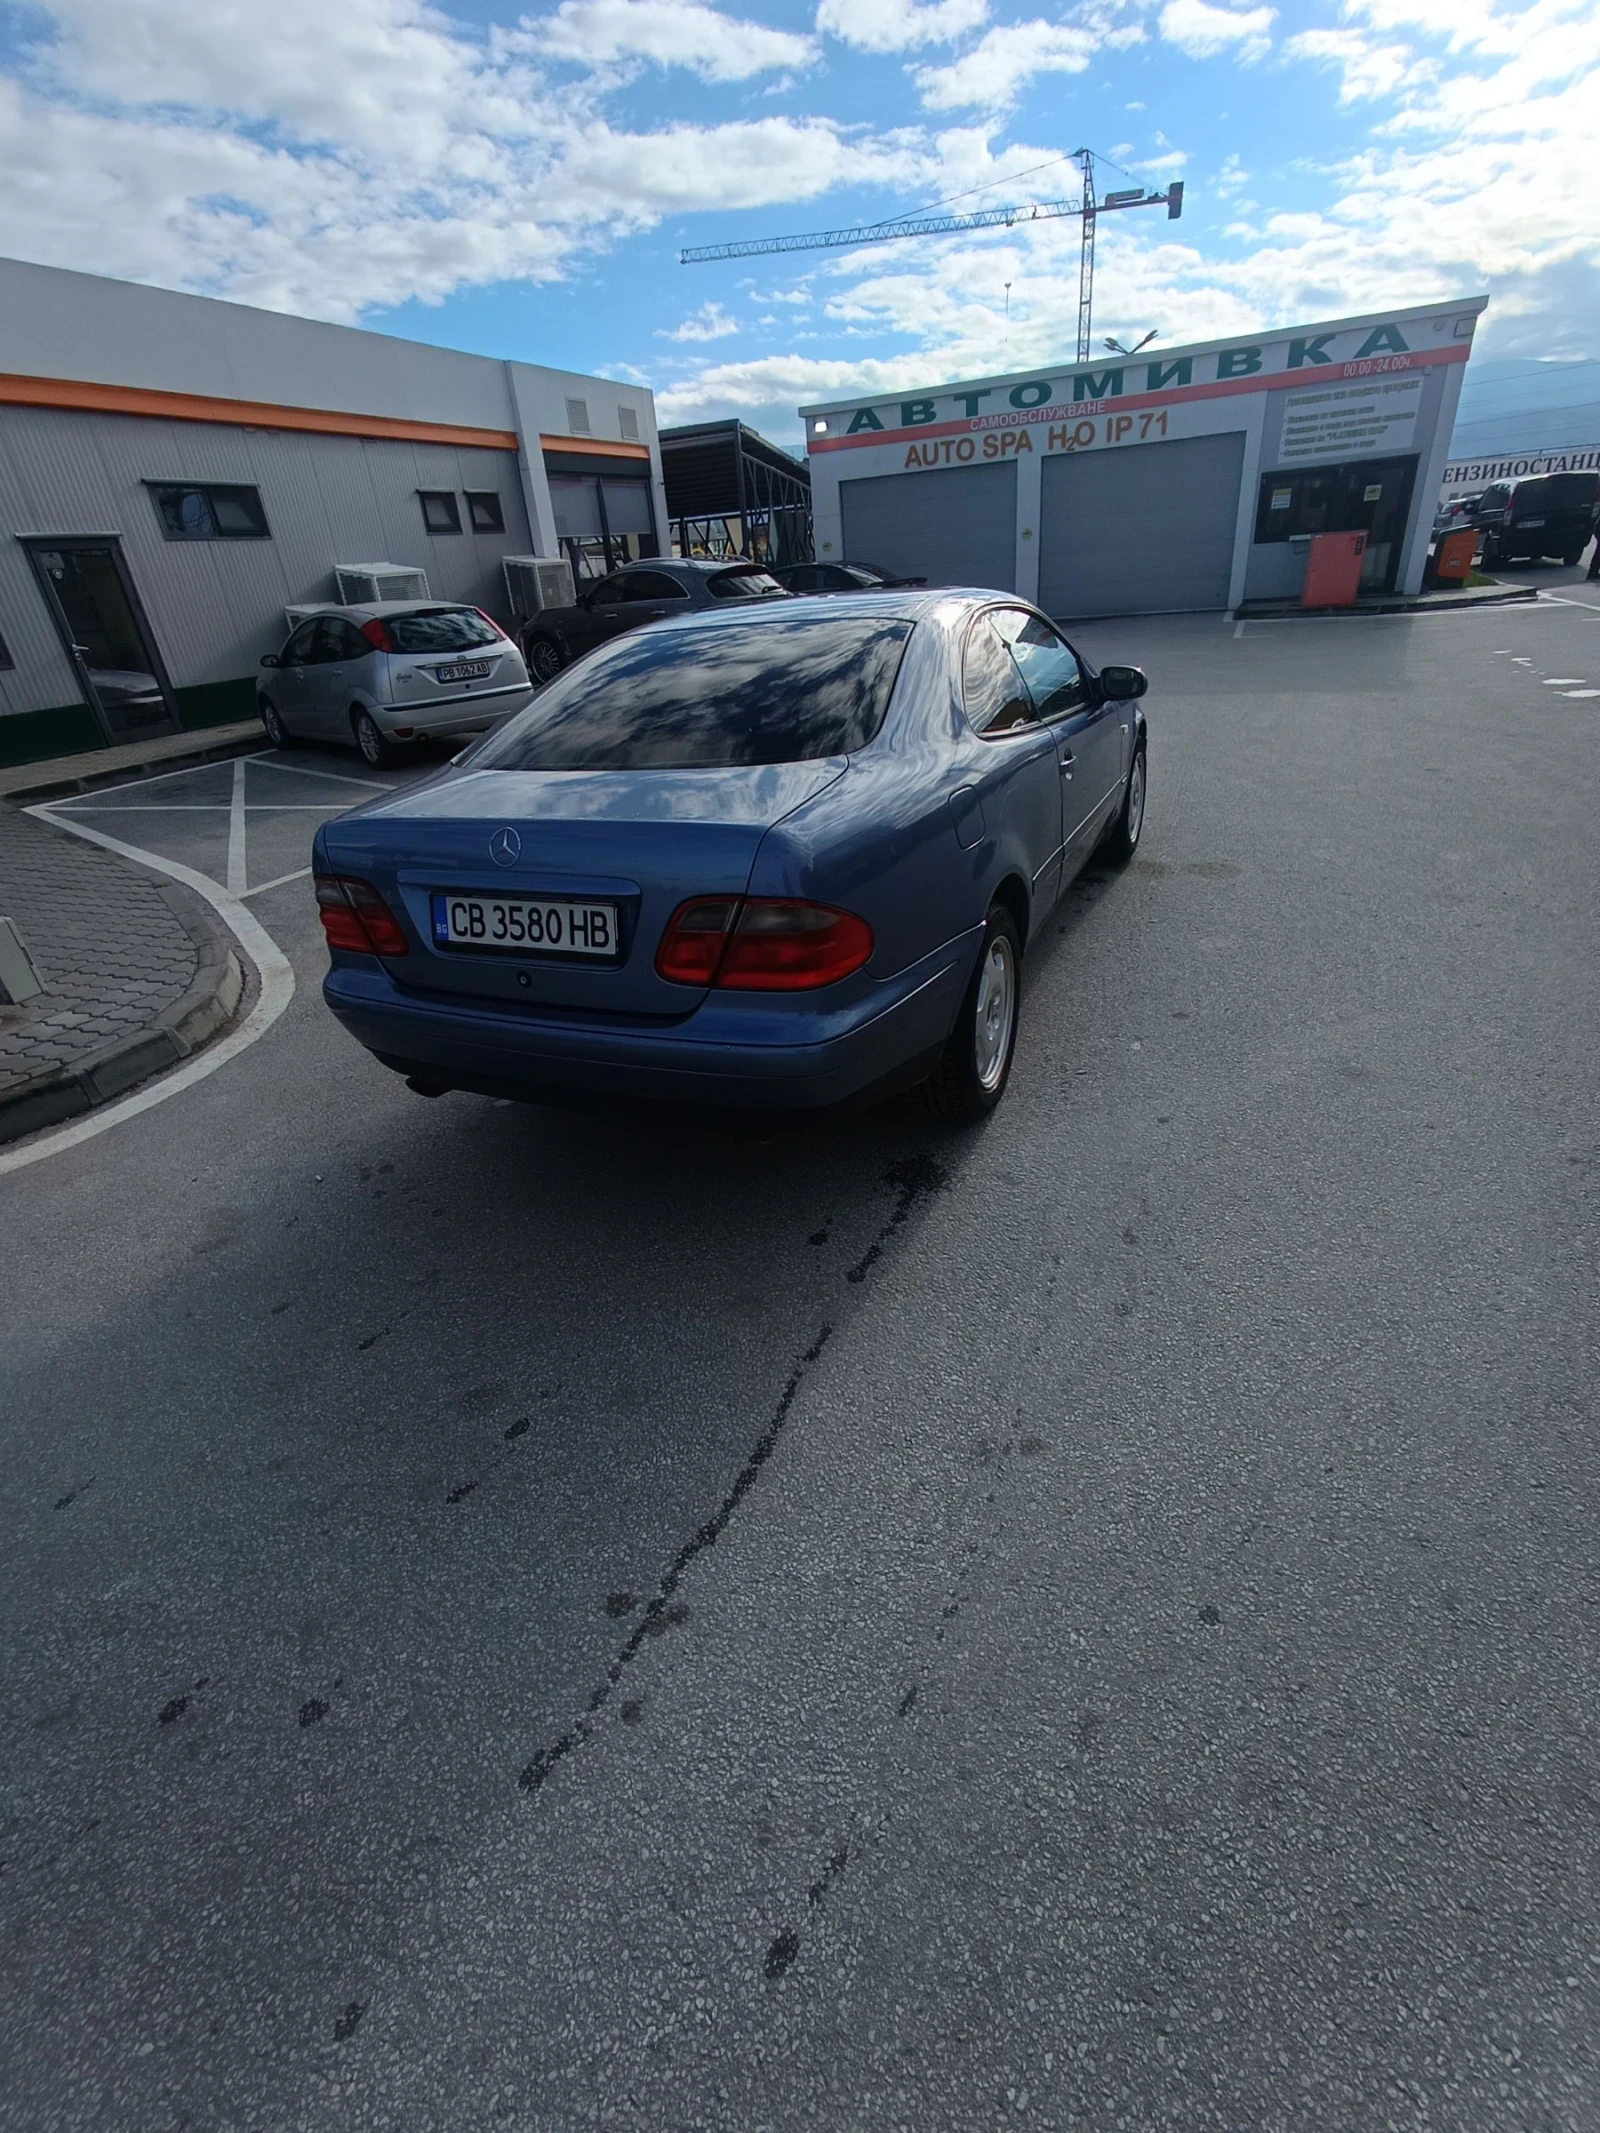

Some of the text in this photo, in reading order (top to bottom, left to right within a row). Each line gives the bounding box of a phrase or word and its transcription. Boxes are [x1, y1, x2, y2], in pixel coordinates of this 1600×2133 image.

[846, 323, 1410, 434] АВТОМИВКА
[1343, 361, 1371, 377] 00.00
[970, 400, 1106, 431] САМООБСЛУЖВАНЕ
[904, 438, 975, 468] AUTO
[983, 429, 1033, 458] SPA
[456, 665, 476, 677] 1062
[436, 923, 447, 934] BG
[451, 902, 610, 948] CB 3580 HB
